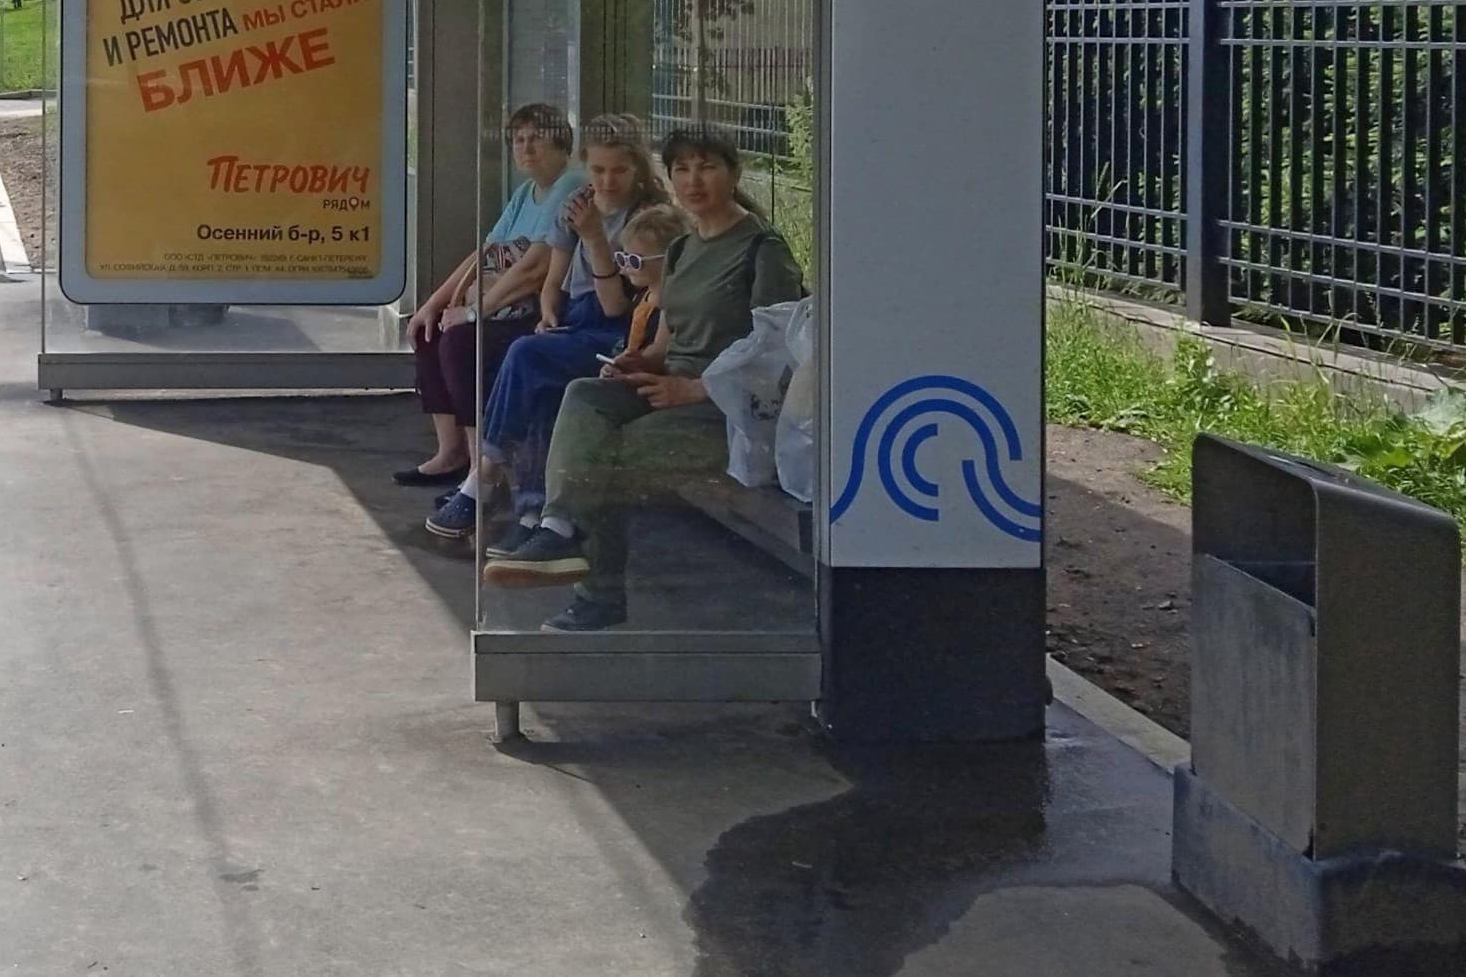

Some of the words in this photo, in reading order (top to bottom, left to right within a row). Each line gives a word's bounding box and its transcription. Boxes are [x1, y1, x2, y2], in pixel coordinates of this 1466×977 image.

[102, 35, 124, 68] И
[125, 7, 239, 62] РЕМОНТА
[241, 4, 286, 32] МЫ
[136, 27, 336, 113] БЛИЖЕ
[197, 223, 283, 241] Осенний
[287, 225, 326, 244] б-р,
[331, 226, 343, 241] 5
[349, 226, 371, 241] к1
